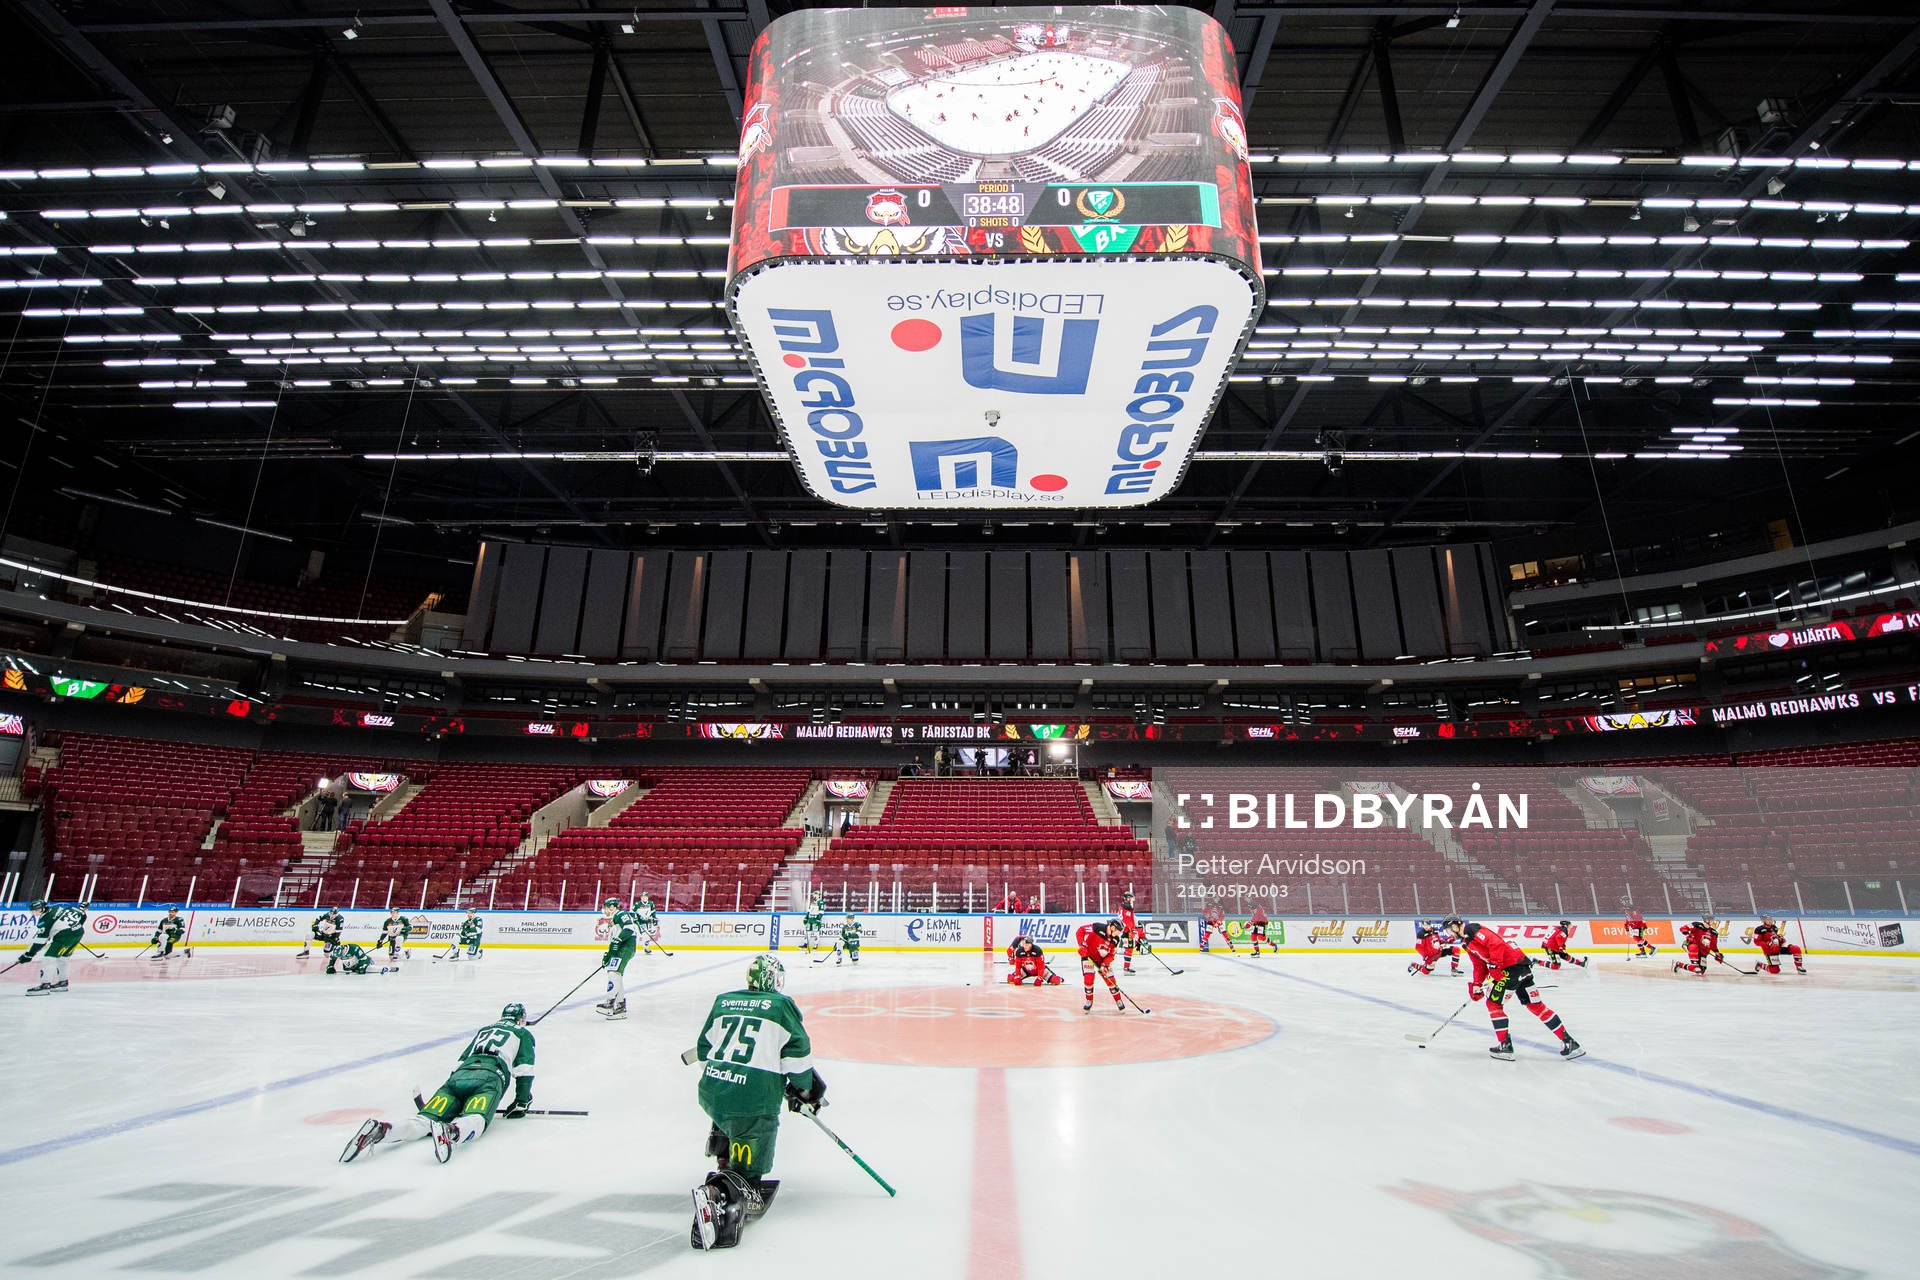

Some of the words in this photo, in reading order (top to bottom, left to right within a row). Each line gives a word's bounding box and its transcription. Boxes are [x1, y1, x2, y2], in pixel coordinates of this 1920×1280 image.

[978, 184, 1009, 193] PERIOD
[1057, 188, 1071, 206] 0
[918, 189, 931, 208] 0
[967, 196, 1020, 214] 38:48
[969, 217, 976, 227] 0
[980, 217, 1009, 227] SHOTS
[1012, 217, 1019, 227] 0
[985, 232, 1004, 248] VS
[887, 284, 1105, 314] LEDdisplay.se
[917, 488, 1065, 503] LEDdisplay.se
[1792, 627, 1842, 646] HJÄRTA
[1711, 704, 1768, 722] MALMÖ
[1771, 692, 1861, 717] REDHAWKS
[796, 723, 834, 739] MALMÖ
[836, 725, 893, 739] REDHAWKS
[922, 724, 975, 739] FÄRJESTAD
[977, 726, 990, 739] BK
[0, 913, 37, 926] EKDA
[926, 918, 962, 930] EKDAHL
[680, 921, 765, 936] sandberg
[926, 931, 947, 943] MILJÖ
[950, 933, 962, 942] AB
[1312, 920, 1346, 937] guld
[1356, 920, 1390, 937] guld
[1826, 924, 1876, 939] madhawk
[473, 1029, 511, 1056] 22
[714, 1016, 763, 1065] 75
[706, 1066, 747, 1085] stadium
